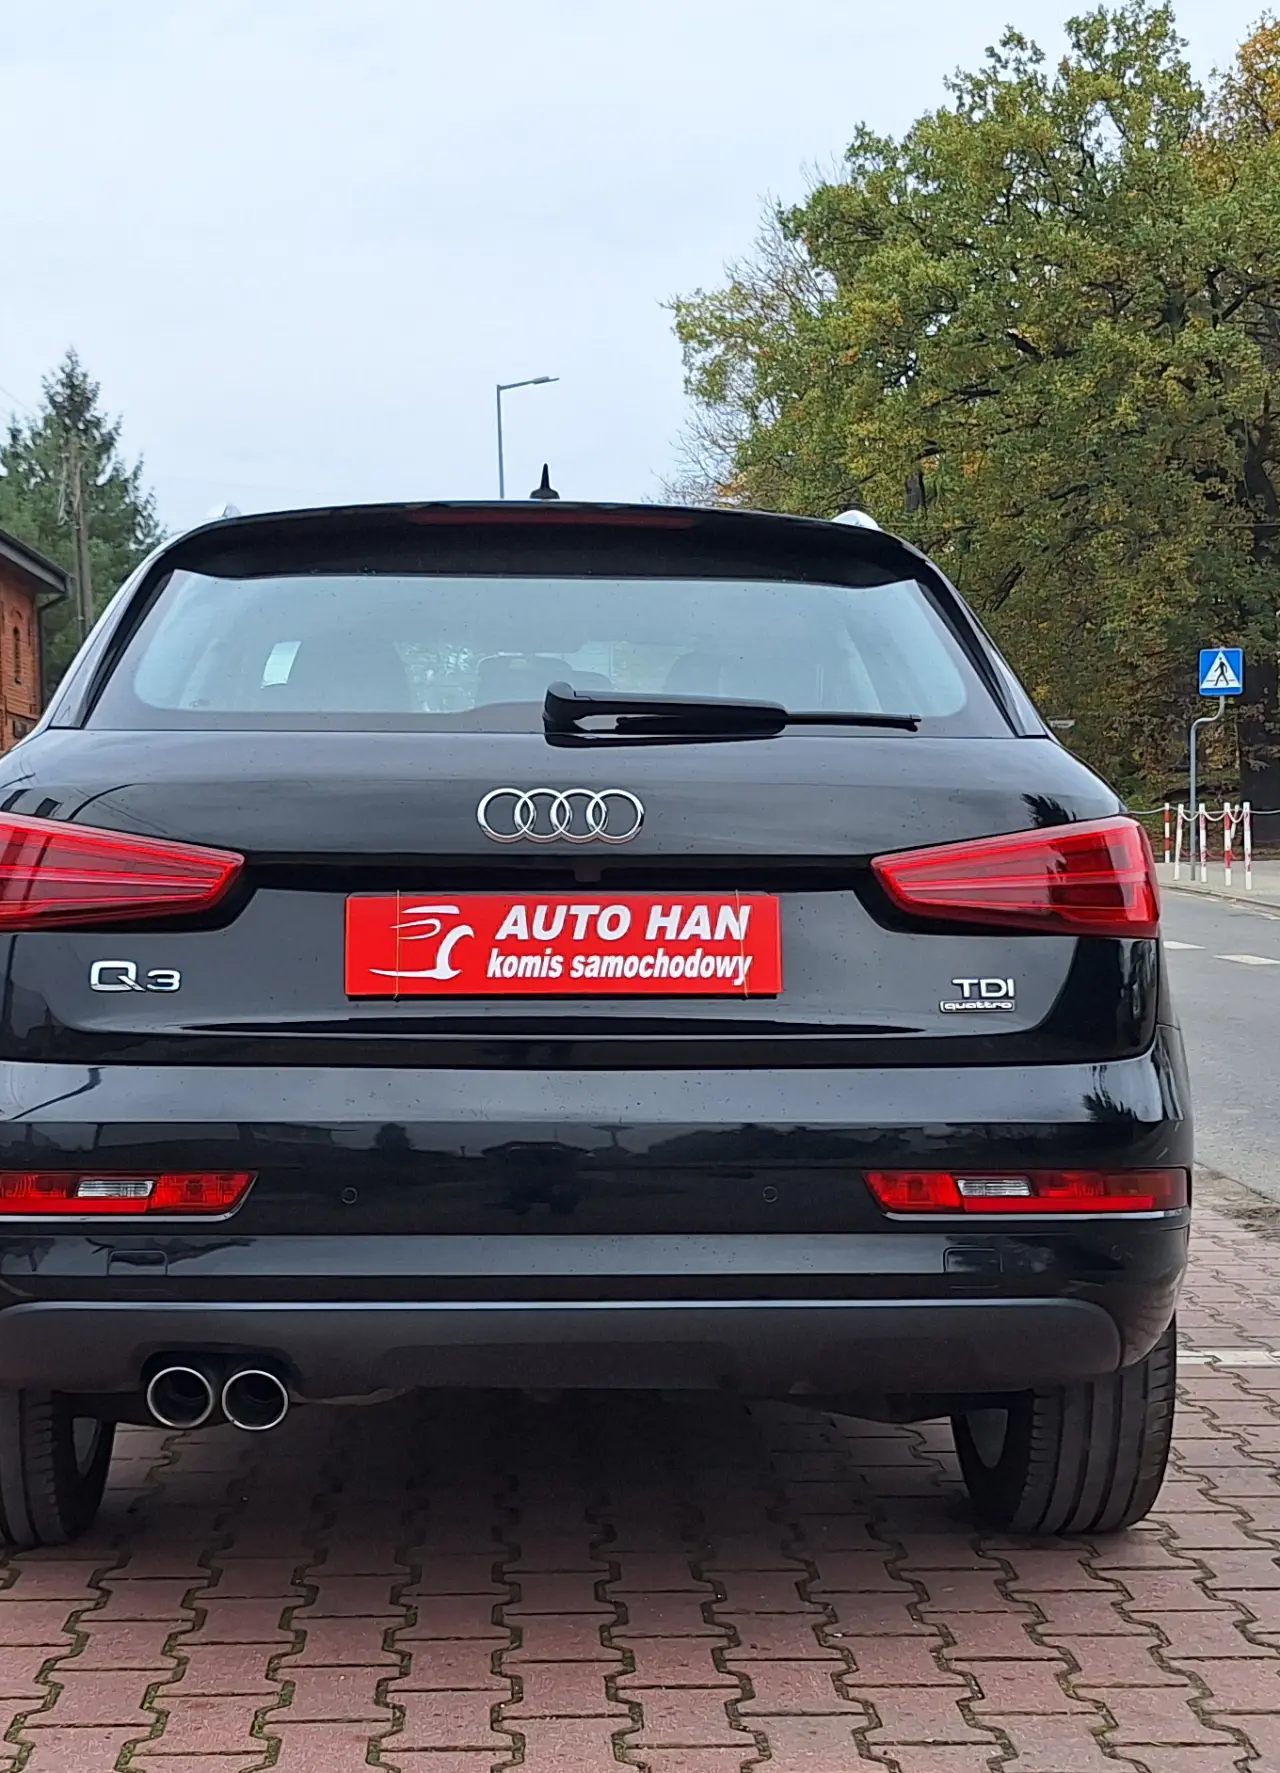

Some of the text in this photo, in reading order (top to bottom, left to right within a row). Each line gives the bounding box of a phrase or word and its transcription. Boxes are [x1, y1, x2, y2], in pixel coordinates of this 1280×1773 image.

[495, 904, 752, 941] AUTO HAN
[90, 960, 181, 992] Q3
[486, 948, 753, 985] komis samochodowy
[952, 978, 1015, 998] TDI
[943, 1001, 1013, 1011] quattro
